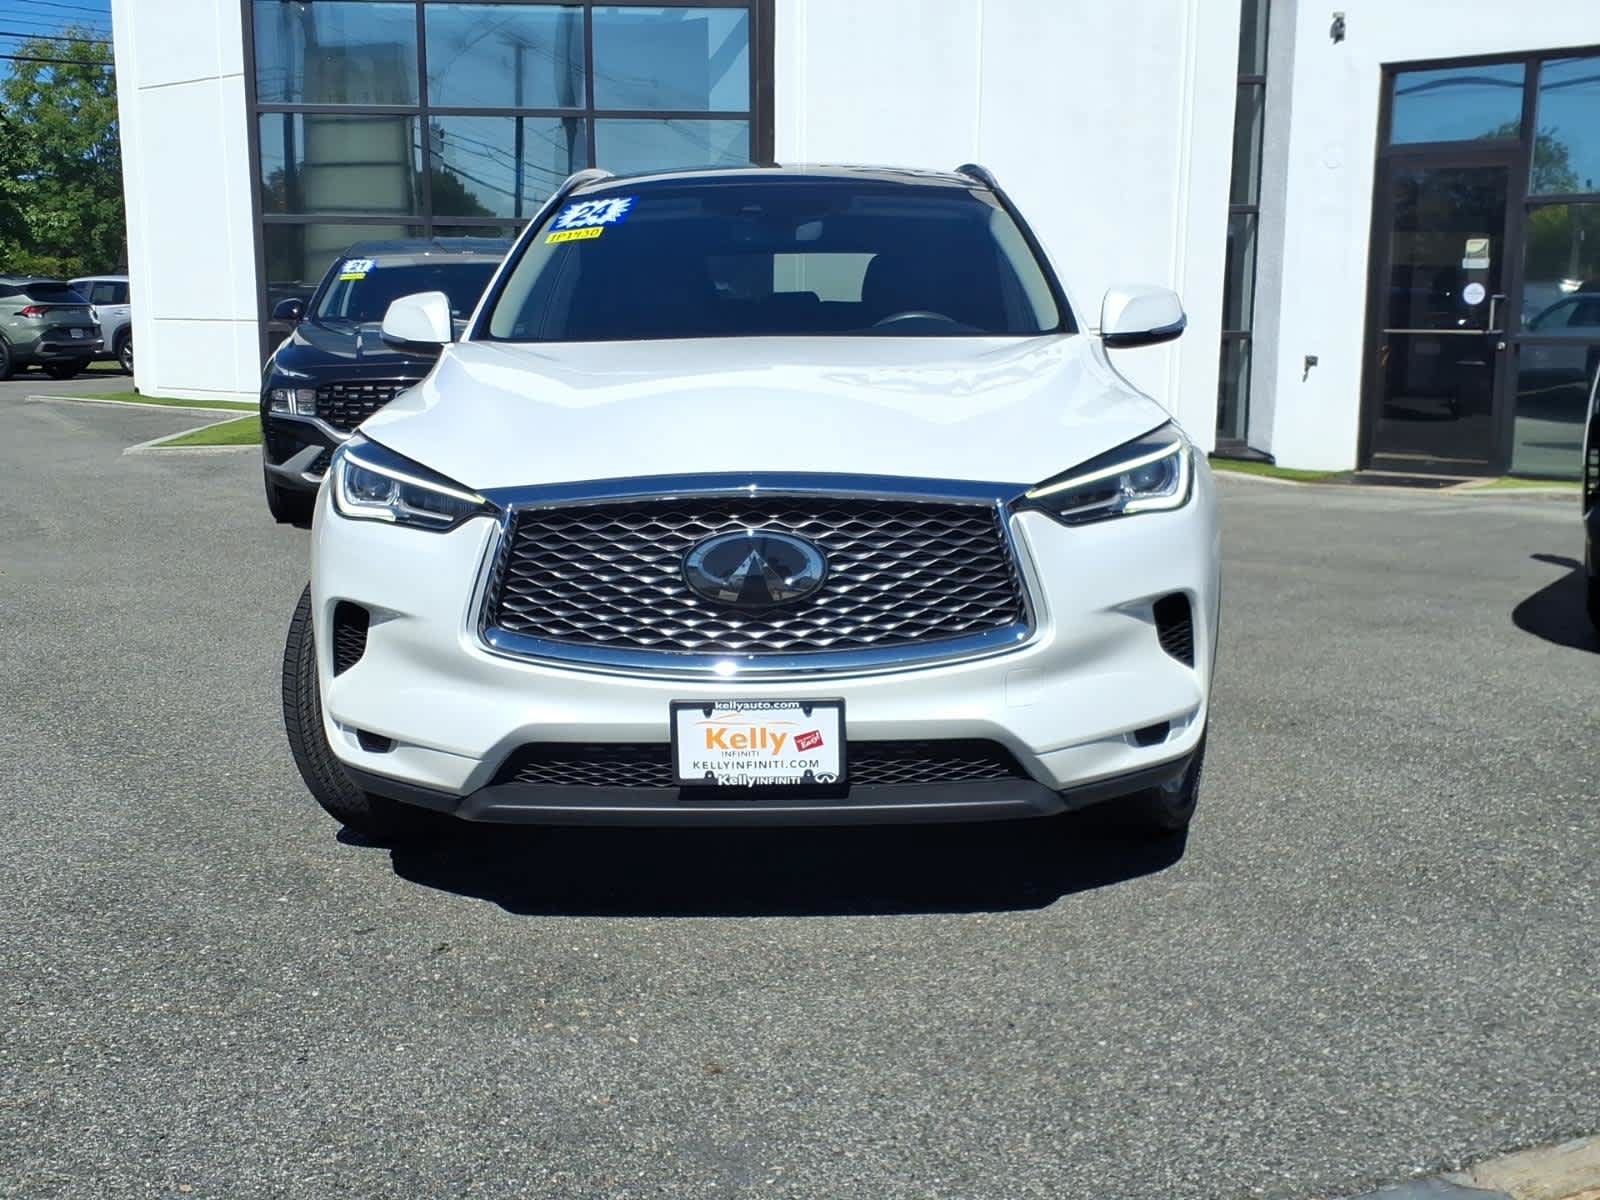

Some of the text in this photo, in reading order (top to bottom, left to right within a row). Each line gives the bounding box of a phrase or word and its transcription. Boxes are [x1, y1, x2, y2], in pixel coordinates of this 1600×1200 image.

[570, 203, 613, 222] 24
[714, 701, 800, 712] kellyauto.com
[705, 727, 787, 755] Kelly
[721, 750, 760, 758] INFINITI
[693, 759, 820, 770] KELLYINFINITI.COM
